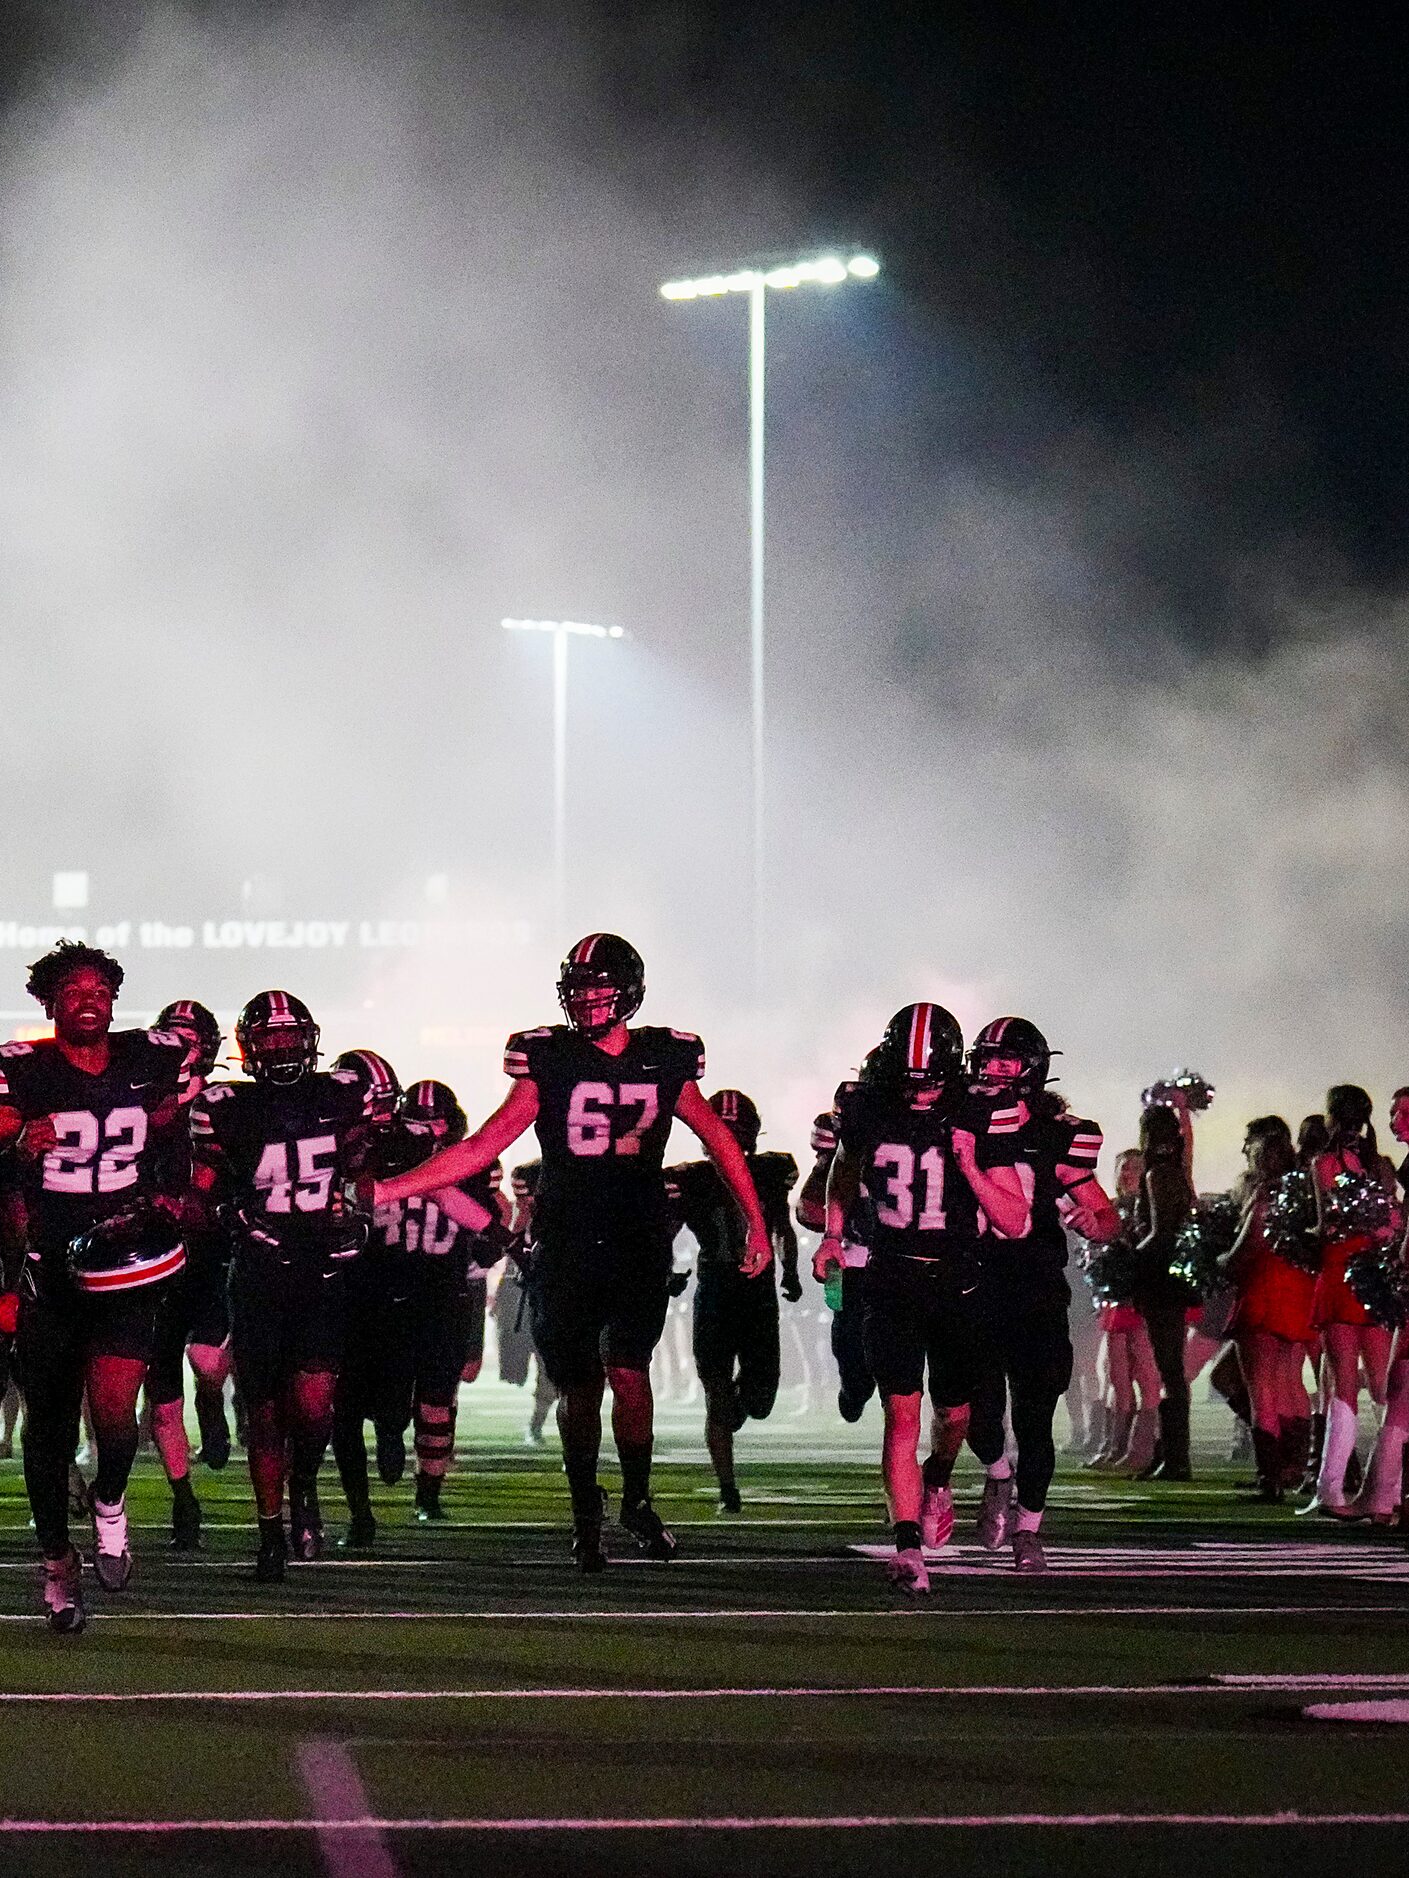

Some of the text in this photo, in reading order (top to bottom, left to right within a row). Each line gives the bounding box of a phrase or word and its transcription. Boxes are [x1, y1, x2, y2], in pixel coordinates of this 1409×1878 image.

[96, 921, 131, 948] of
[141, 921, 193, 948] the
[203, 921, 350, 948] LOVEJOY
[42, 1105, 149, 1194] 22
[566, 1081, 660, 1157] 67
[253, 1134, 338, 1214] 45
[873, 1142, 947, 1231] 31
